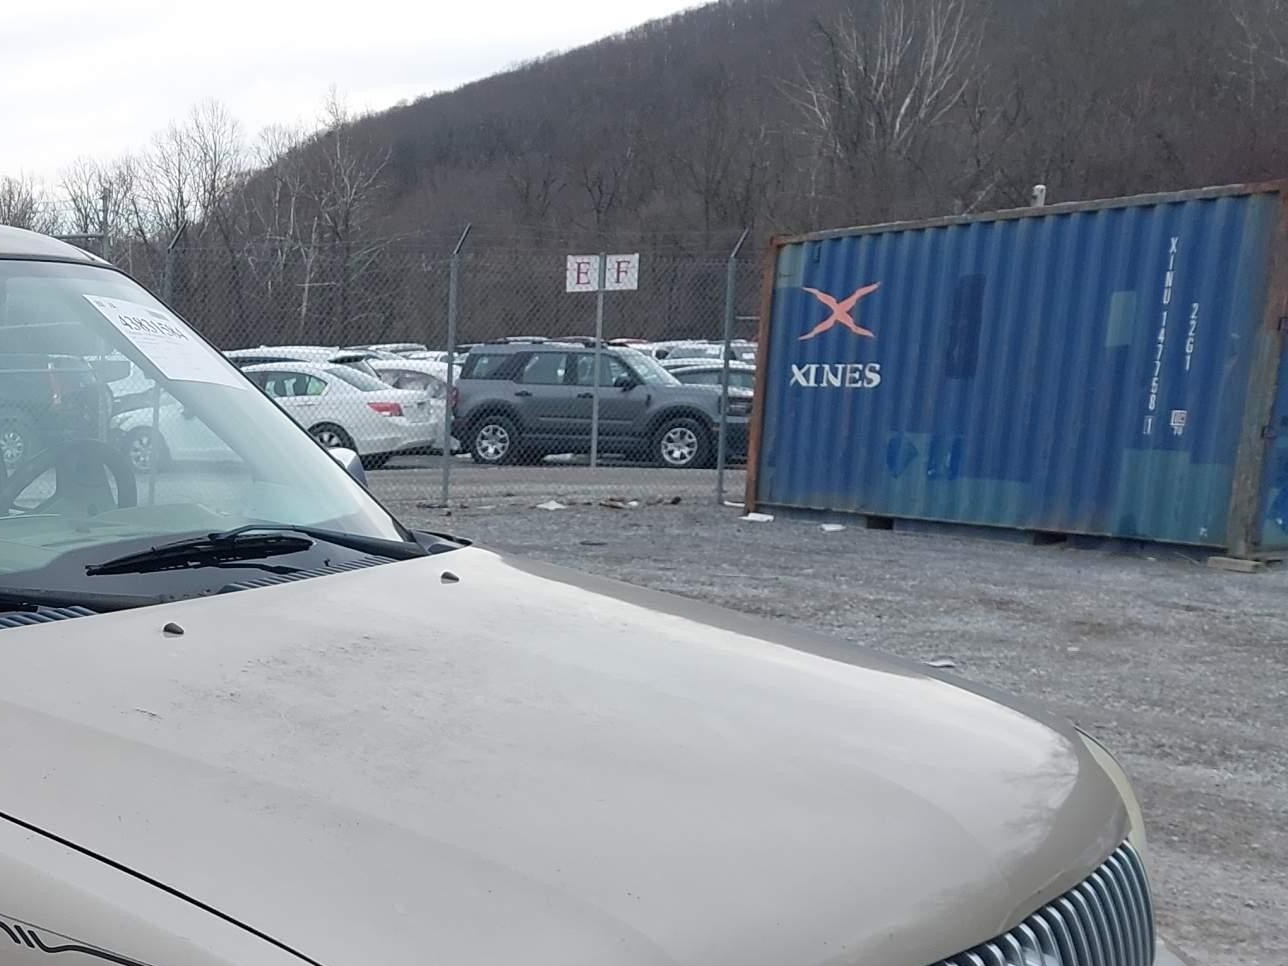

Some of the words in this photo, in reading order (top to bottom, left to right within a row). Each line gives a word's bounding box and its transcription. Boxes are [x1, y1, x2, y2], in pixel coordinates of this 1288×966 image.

[575, 261, 591, 285] E
[615, 260, 631, 284] F
[1162, 236, 1179, 304] XINU
[1185, 302, 1200, 371] 22G1
[790, 362, 881, 388] XINES
